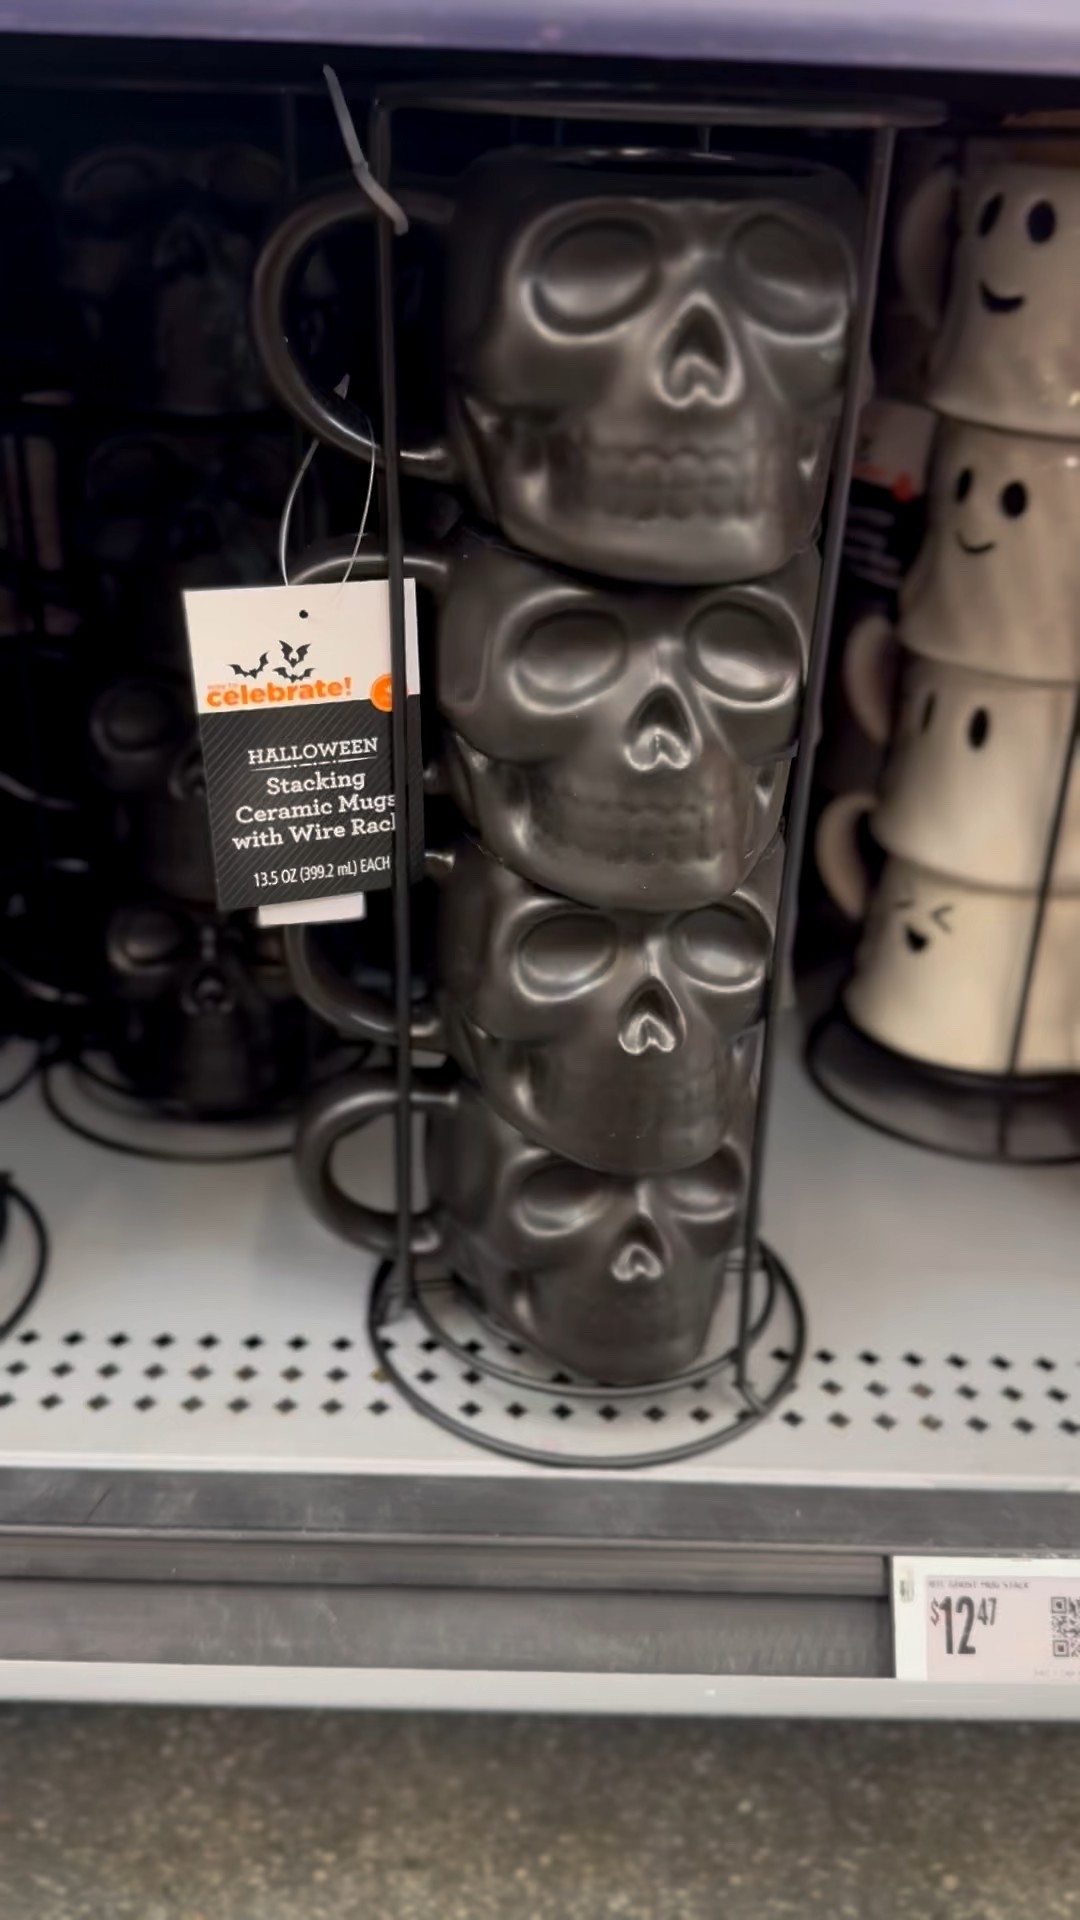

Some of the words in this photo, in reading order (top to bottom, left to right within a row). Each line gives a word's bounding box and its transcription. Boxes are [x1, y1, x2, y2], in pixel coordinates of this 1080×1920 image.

[206, 677, 352, 707] celebrate!
[248, 737, 379, 765] HALLOWEEN
[266, 771, 366, 796] Stacking
[235, 798, 333, 824] Ceramic
[338, 793, 396, 814] Mugs
[231, 827, 284, 851] with
[288, 823, 346, 843] Wire
[253, 872, 279, 888] 13.5
[281, 868, 298, 884] OZ
[300, 863, 334, 884] (399.2
[337, 859, 358, 877] mL)
[360, 855, 392, 873] EACH
